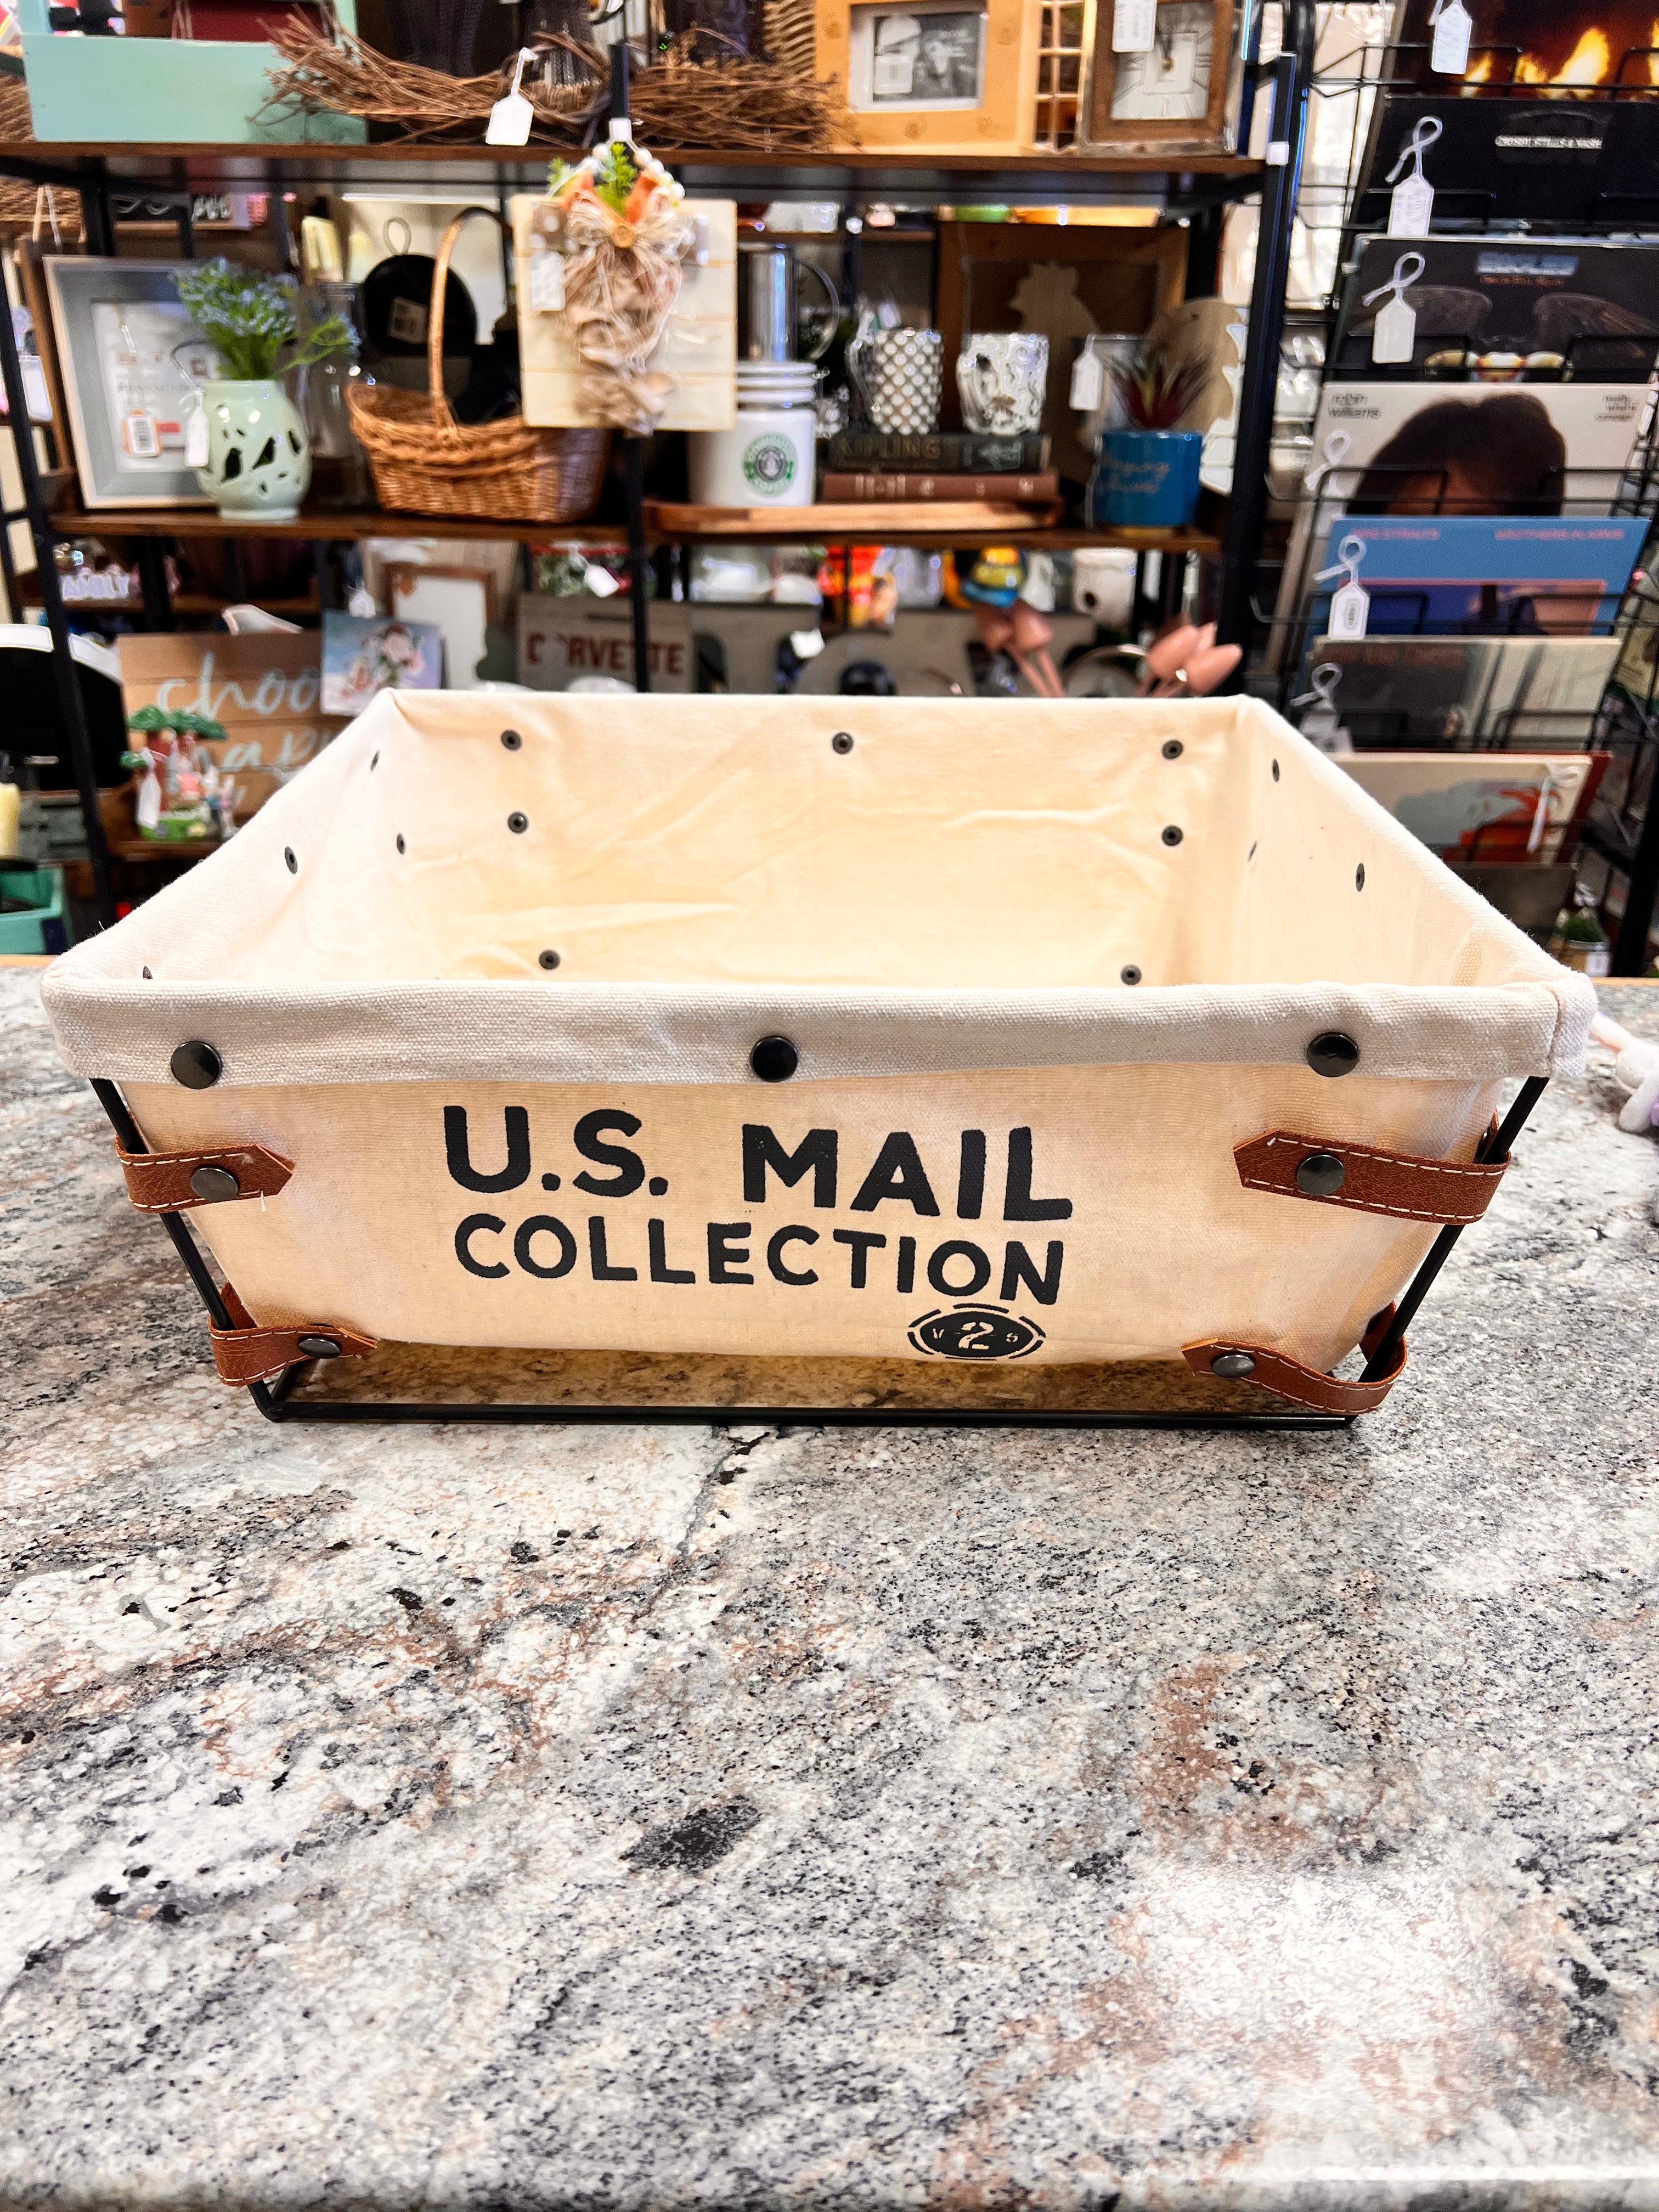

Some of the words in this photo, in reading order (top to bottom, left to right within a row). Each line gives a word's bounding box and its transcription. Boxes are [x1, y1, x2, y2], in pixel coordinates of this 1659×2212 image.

[526, 632, 684, 676] CRVETE
[444, 1105, 668, 1198] U.S.
[742, 1124, 1073, 1221] MAIL
[455, 1213, 1063, 1305] COLLECTION
[958, 1322, 994, 1350] 2
